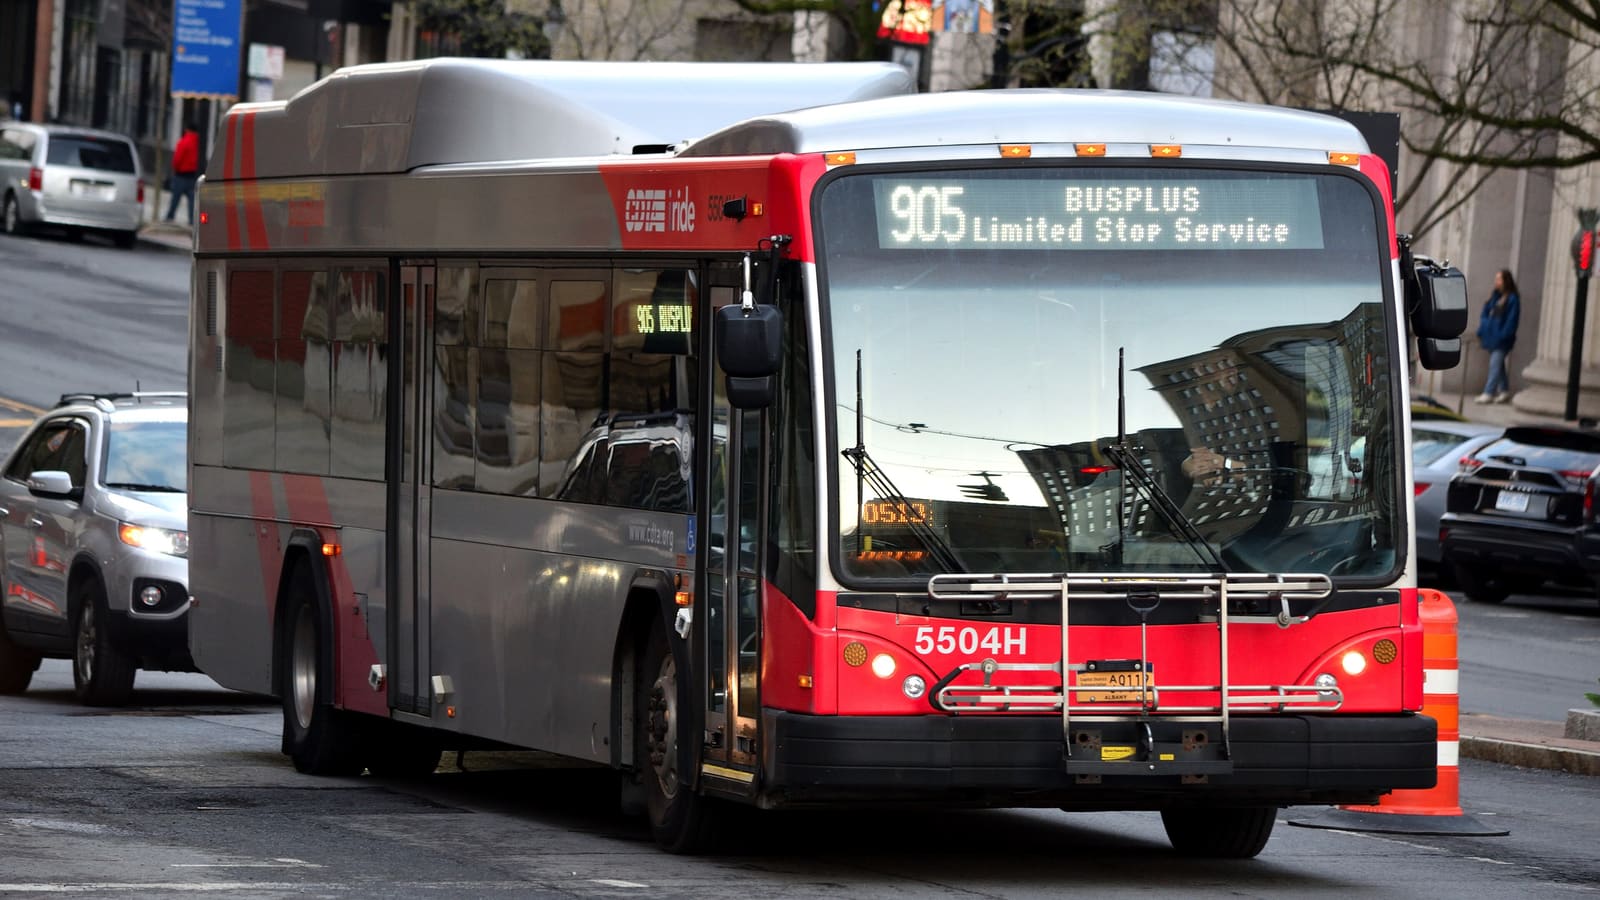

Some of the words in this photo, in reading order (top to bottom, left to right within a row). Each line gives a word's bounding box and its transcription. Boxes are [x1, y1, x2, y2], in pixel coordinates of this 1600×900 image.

[625, 188, 666, 232] CDTA
[891, 186, 966, 242] 905
[1065, 187, 1201, 212] BUSPLUS
[973, 217, 1083, 242] Limited
[1095, 217, 1162, 242] Stop
[1174, 217, 1289, 242] Service
[636, 304, 655, 333] 905
[914, 626, 1027, 656] 5504H
